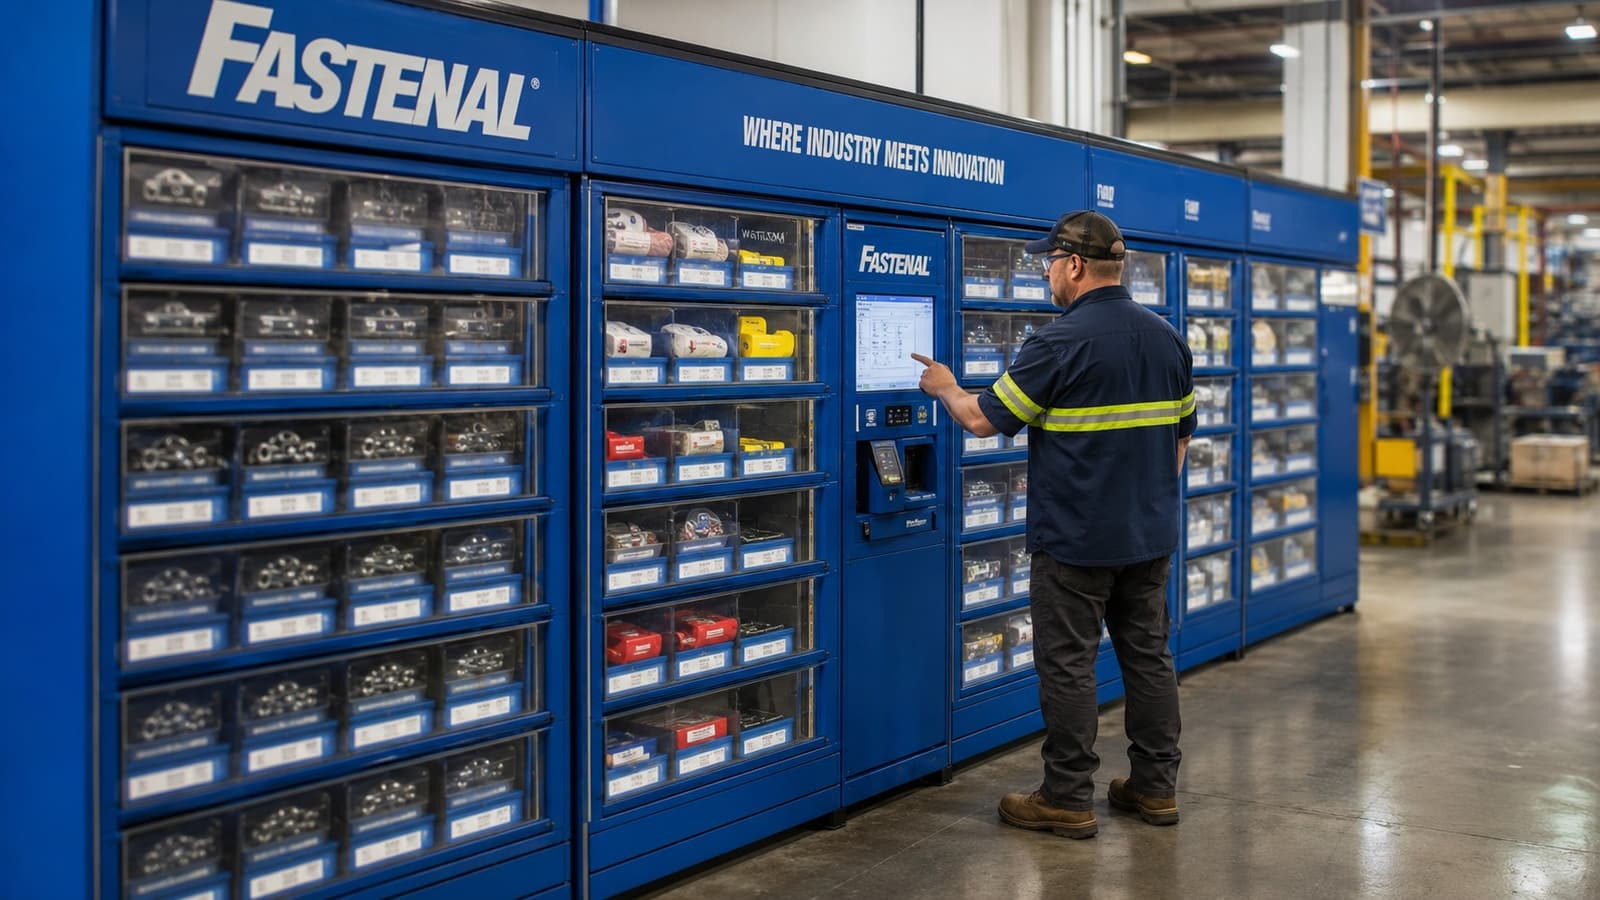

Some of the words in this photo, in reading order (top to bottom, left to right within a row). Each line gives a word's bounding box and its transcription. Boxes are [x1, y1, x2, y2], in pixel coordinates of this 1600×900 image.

[744, 115, 803, 154] WHERE
[807, 127, 881, 166] INDUSTRY
[885, 140, 930, 175] MEETS
[933, 149, 1005, 186] INNOVATION
[859, 245, 931, 276] FASTENAL
